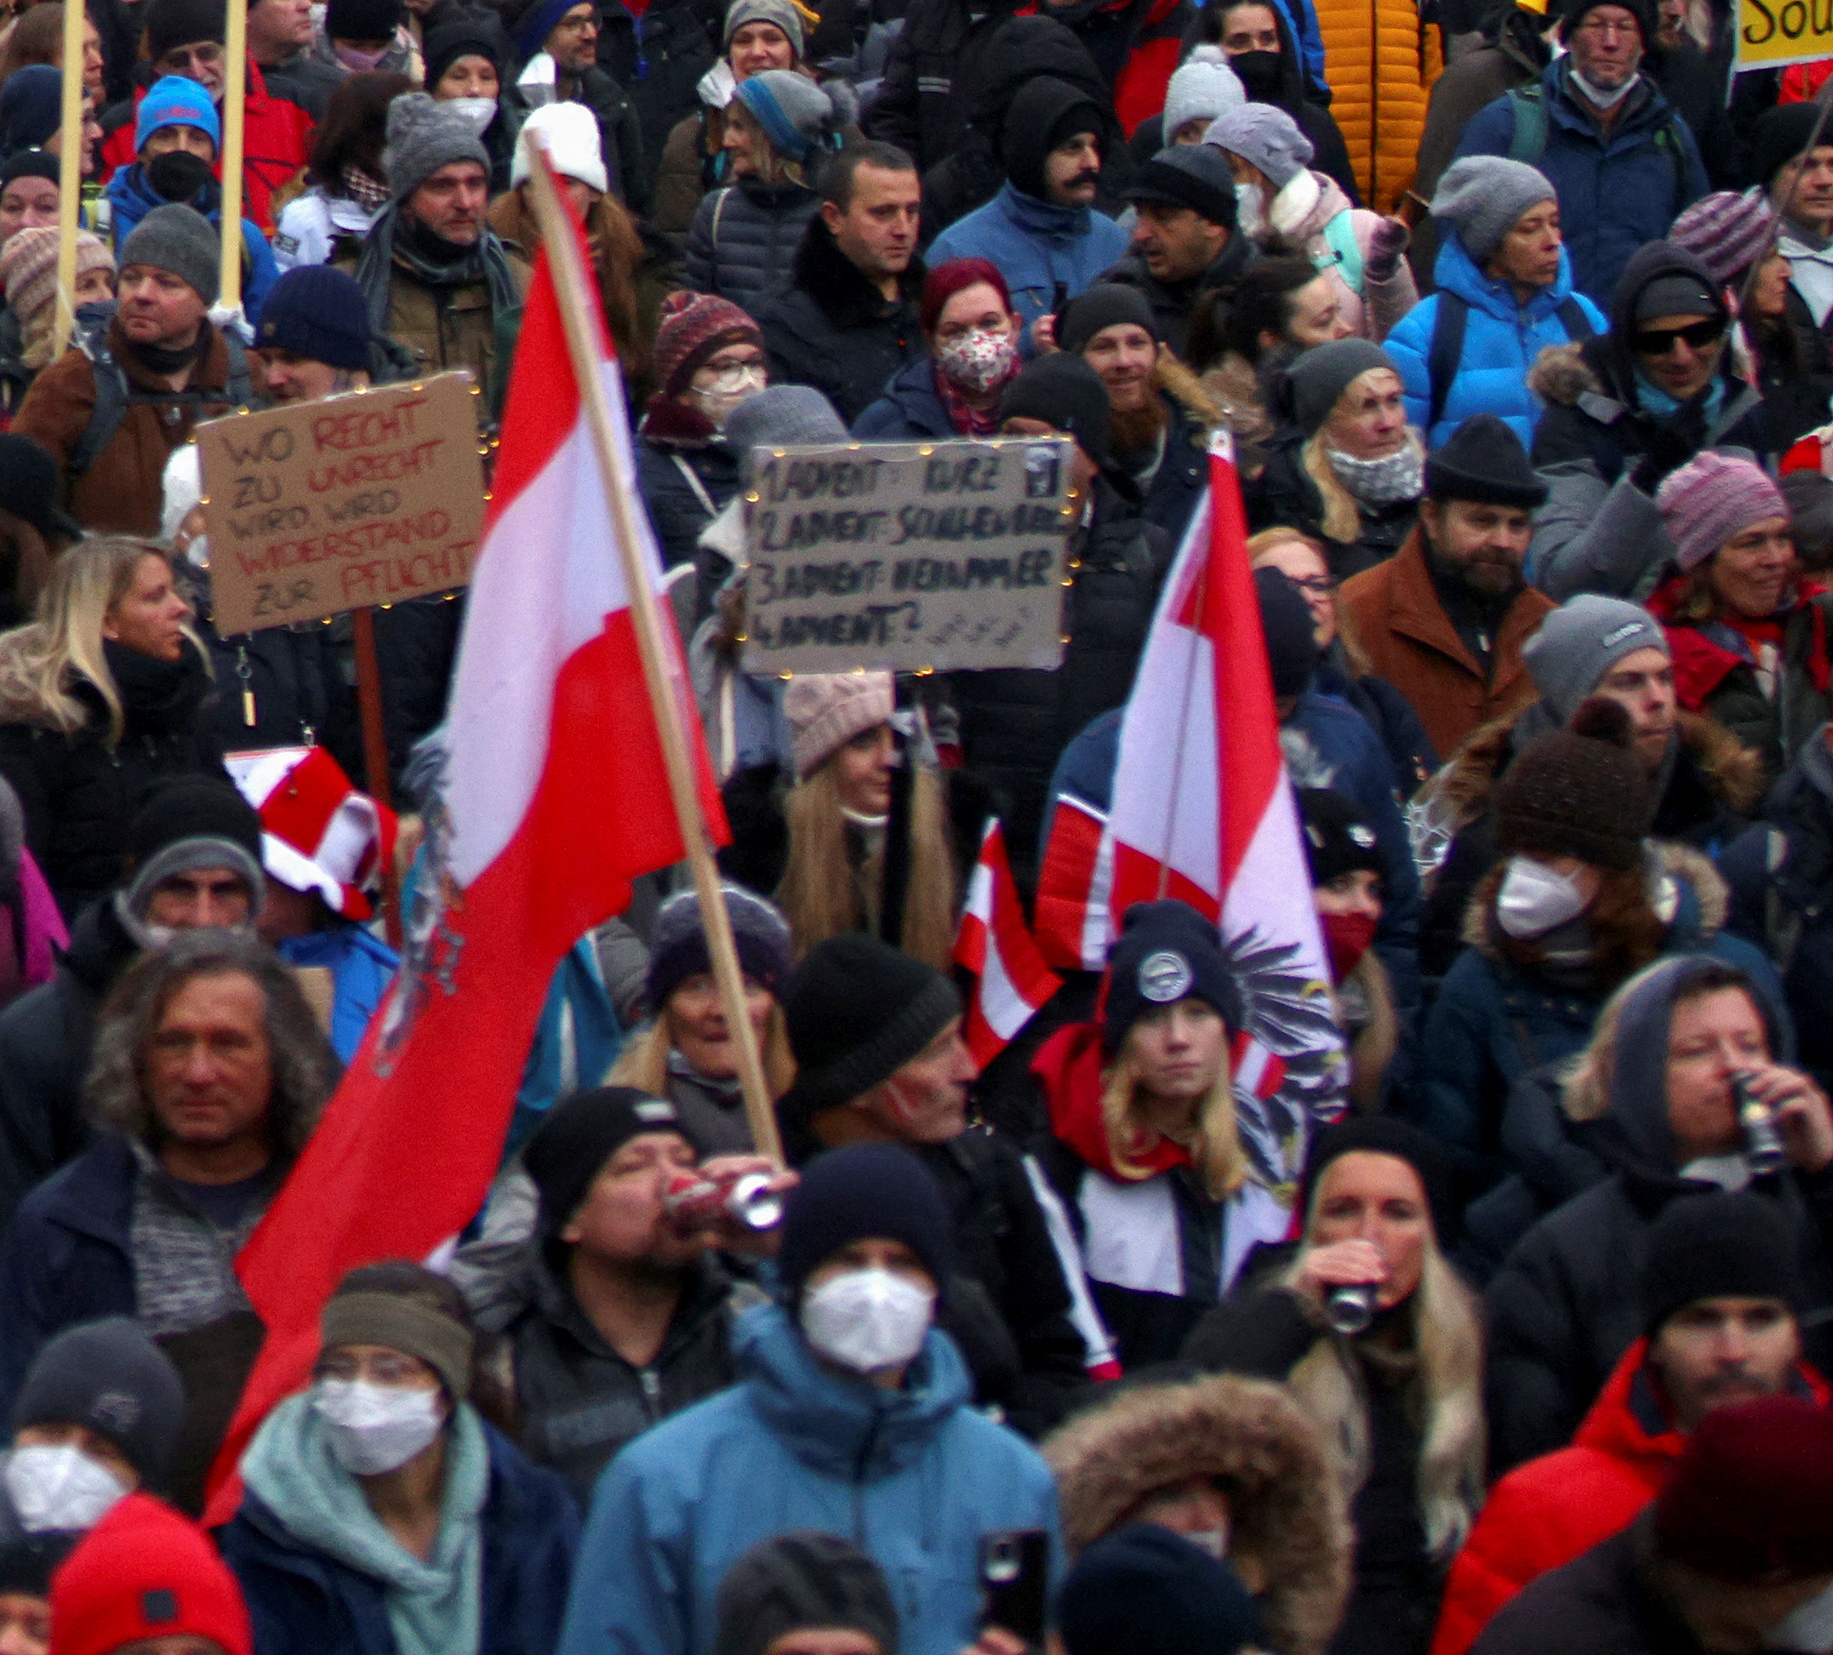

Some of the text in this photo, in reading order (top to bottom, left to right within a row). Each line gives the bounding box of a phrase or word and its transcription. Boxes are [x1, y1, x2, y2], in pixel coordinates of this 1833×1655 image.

[222, 397, 428, 466] WO RECHT
[232, 439, 447, 510] ZU UNRECHT
[323, 488, 401, 524] WIRD
[924, 456, 1002, 494] KURZ
[235, 509, 453, 577] WIDERSTAND
[892, 548, 1054, 592] NEHAMMER
[251, 539, 478, 617] ZUR PFLICHT
